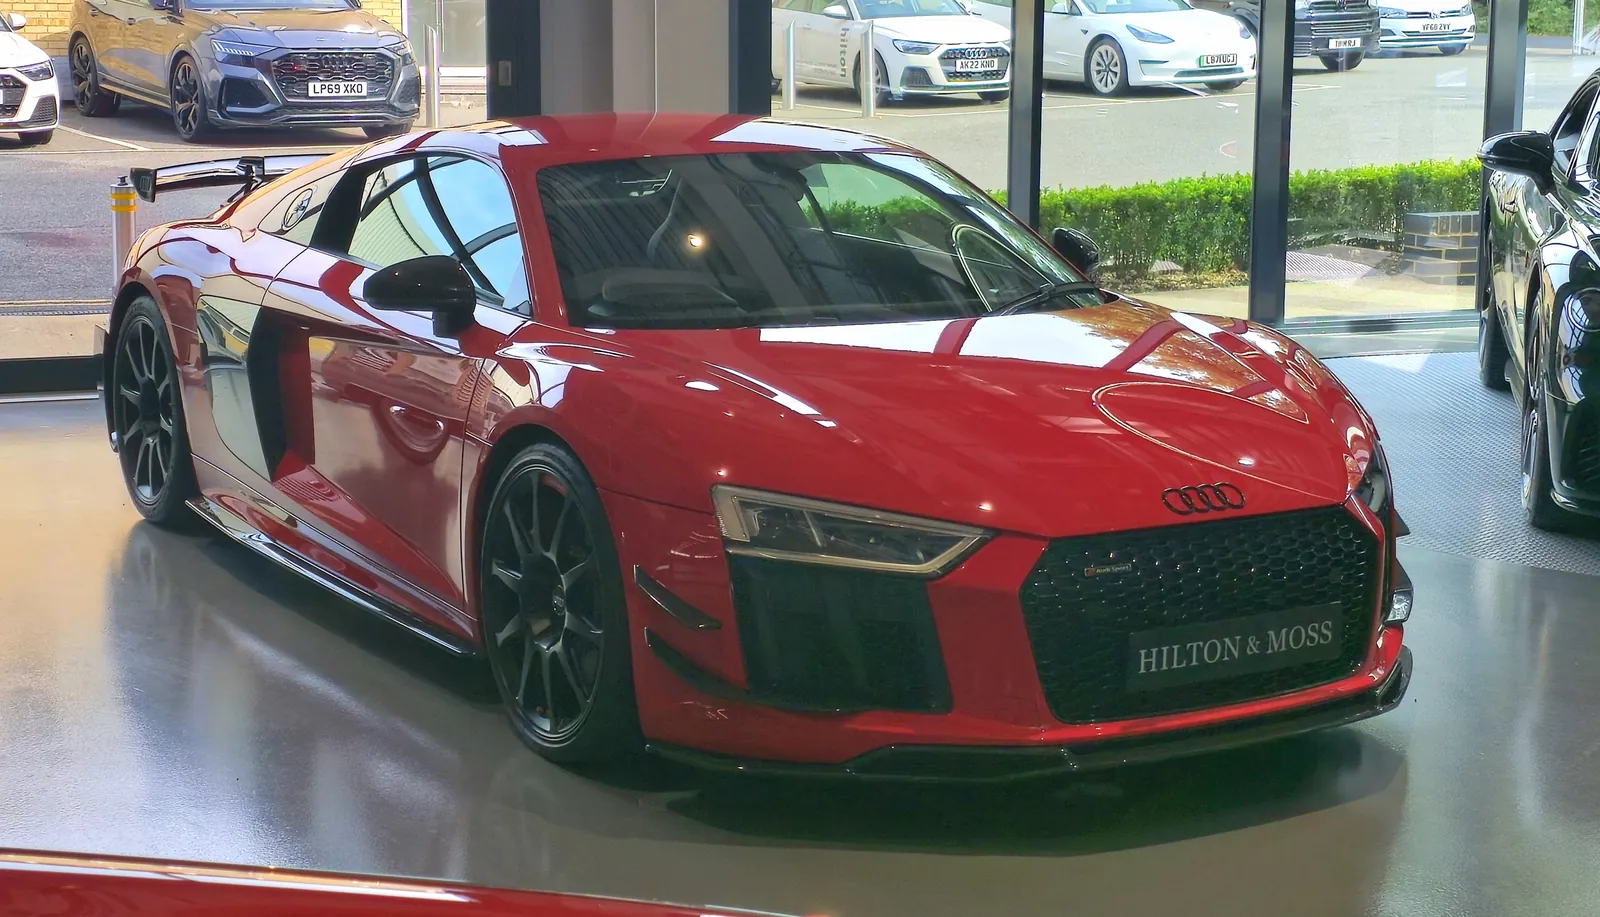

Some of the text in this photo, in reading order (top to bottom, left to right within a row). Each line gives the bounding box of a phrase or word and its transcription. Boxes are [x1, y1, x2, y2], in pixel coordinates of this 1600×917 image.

[840, 27, 850, 78] hilton
[959, 60, 979, 70] AK22
[313, 83, 341, 94] LP69
[1138, 620, 1333, 674] HILTON & MOSS
